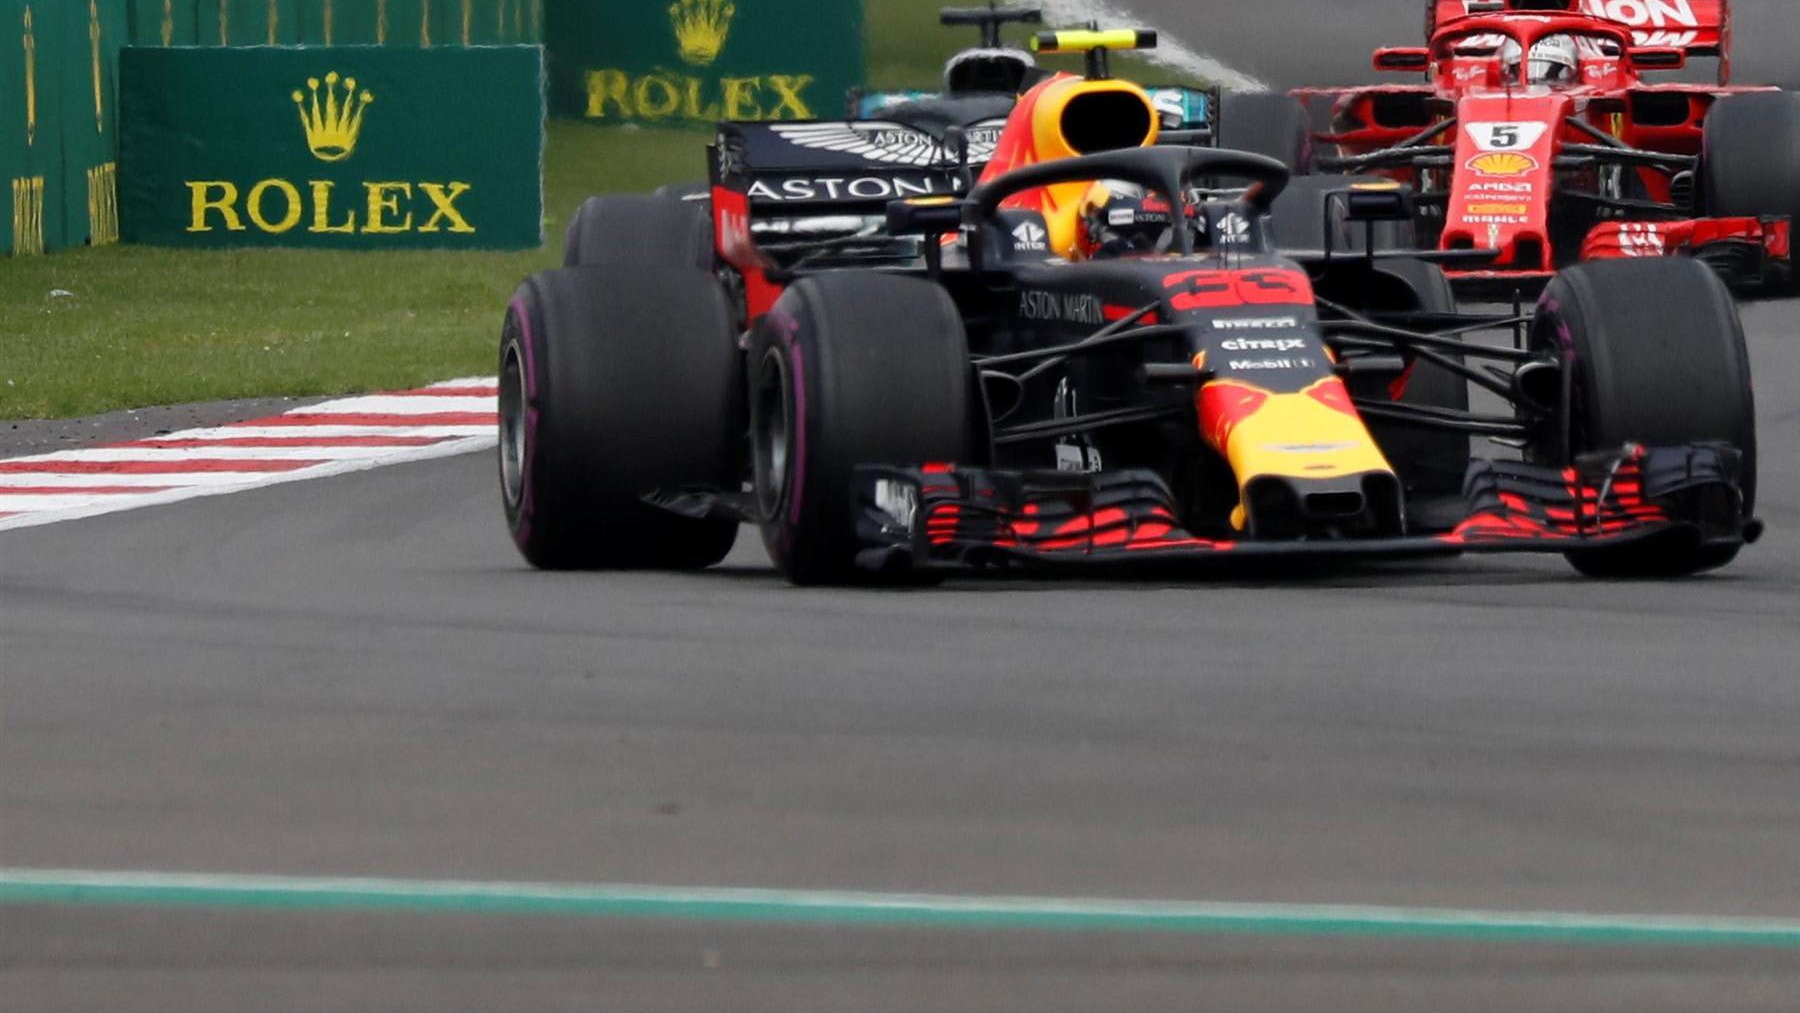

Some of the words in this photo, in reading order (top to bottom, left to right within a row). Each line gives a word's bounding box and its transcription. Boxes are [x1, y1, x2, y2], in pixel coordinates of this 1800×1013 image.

[584, 67, 819, 121] ROLEX
[873, 130, 932, 146] ASTON
[1489, 126, 1518, 148] 5
[747, 177, 934, 200] ASTON
[185, 178, 476, 235] ROLEX
[1163, 267, 1315, 312] 33
[1020, 290, 1060, 320] ASTON
[1063, 292, 1104, 324] MARTIN
[1228, 358, 1292, 371] Mobil
